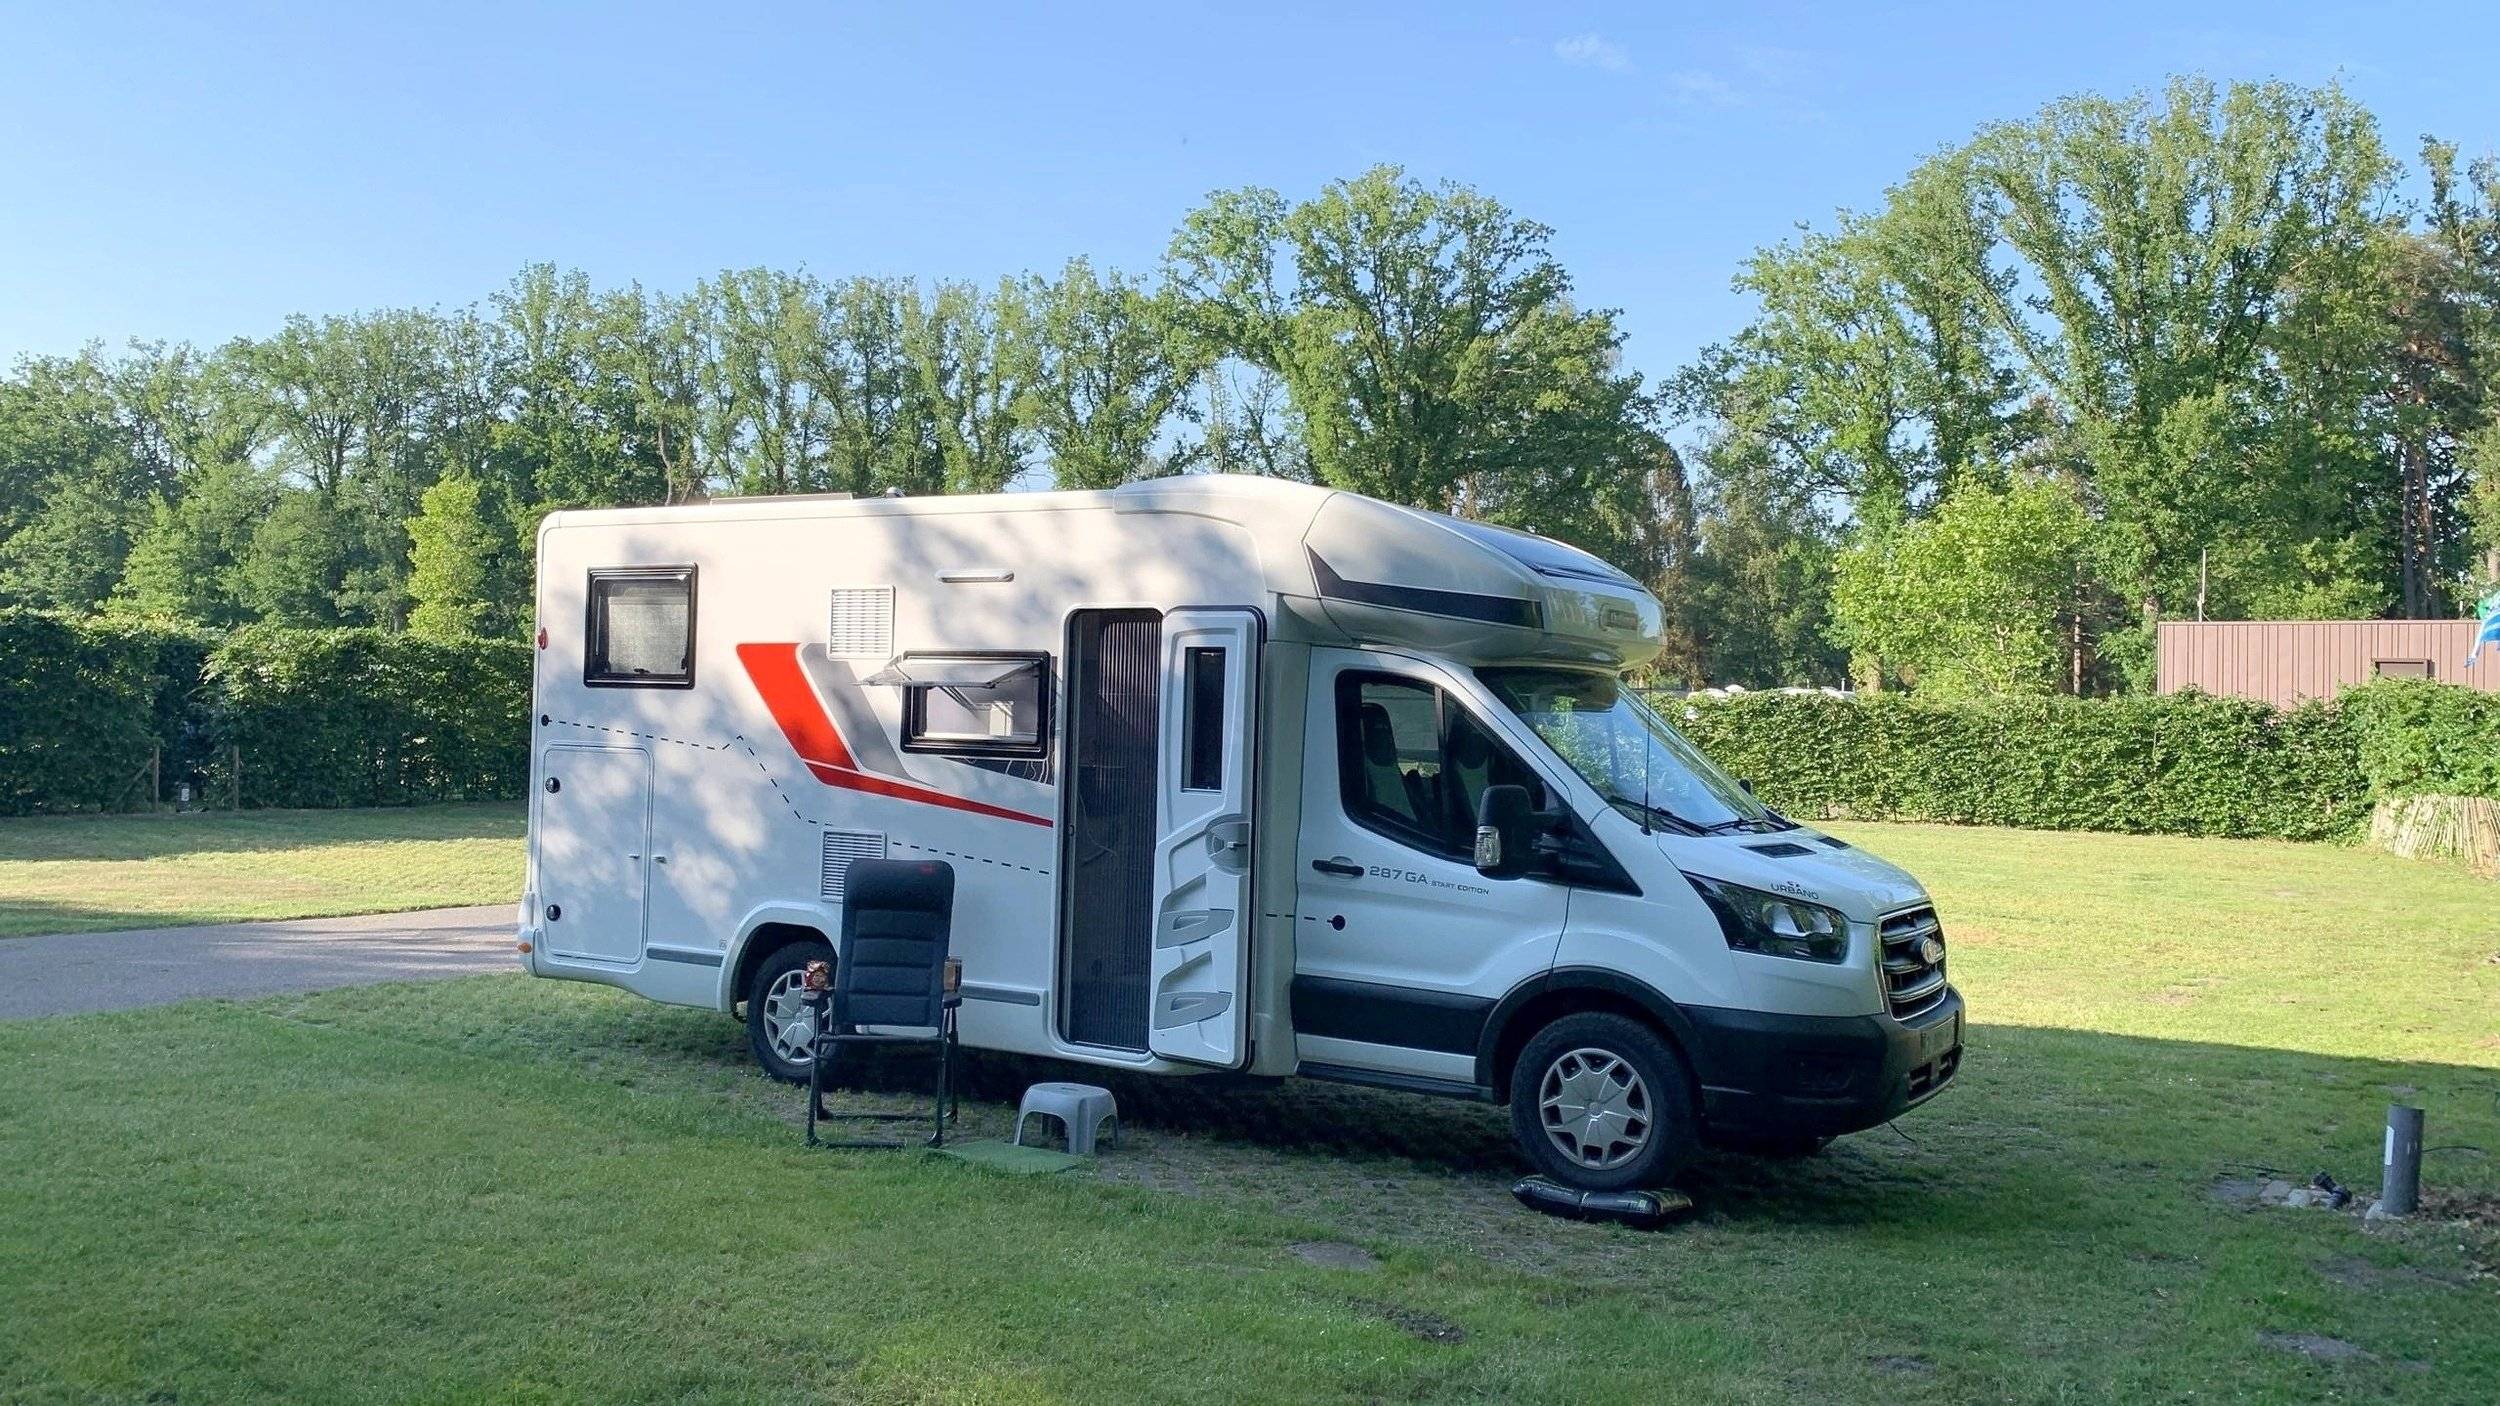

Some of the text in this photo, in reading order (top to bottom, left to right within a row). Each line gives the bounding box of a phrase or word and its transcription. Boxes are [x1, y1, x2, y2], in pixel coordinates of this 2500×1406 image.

[1369, 866, 1489, 895] 287 GA START EDITION
[1770, 883, 1819, 899] URBANO
